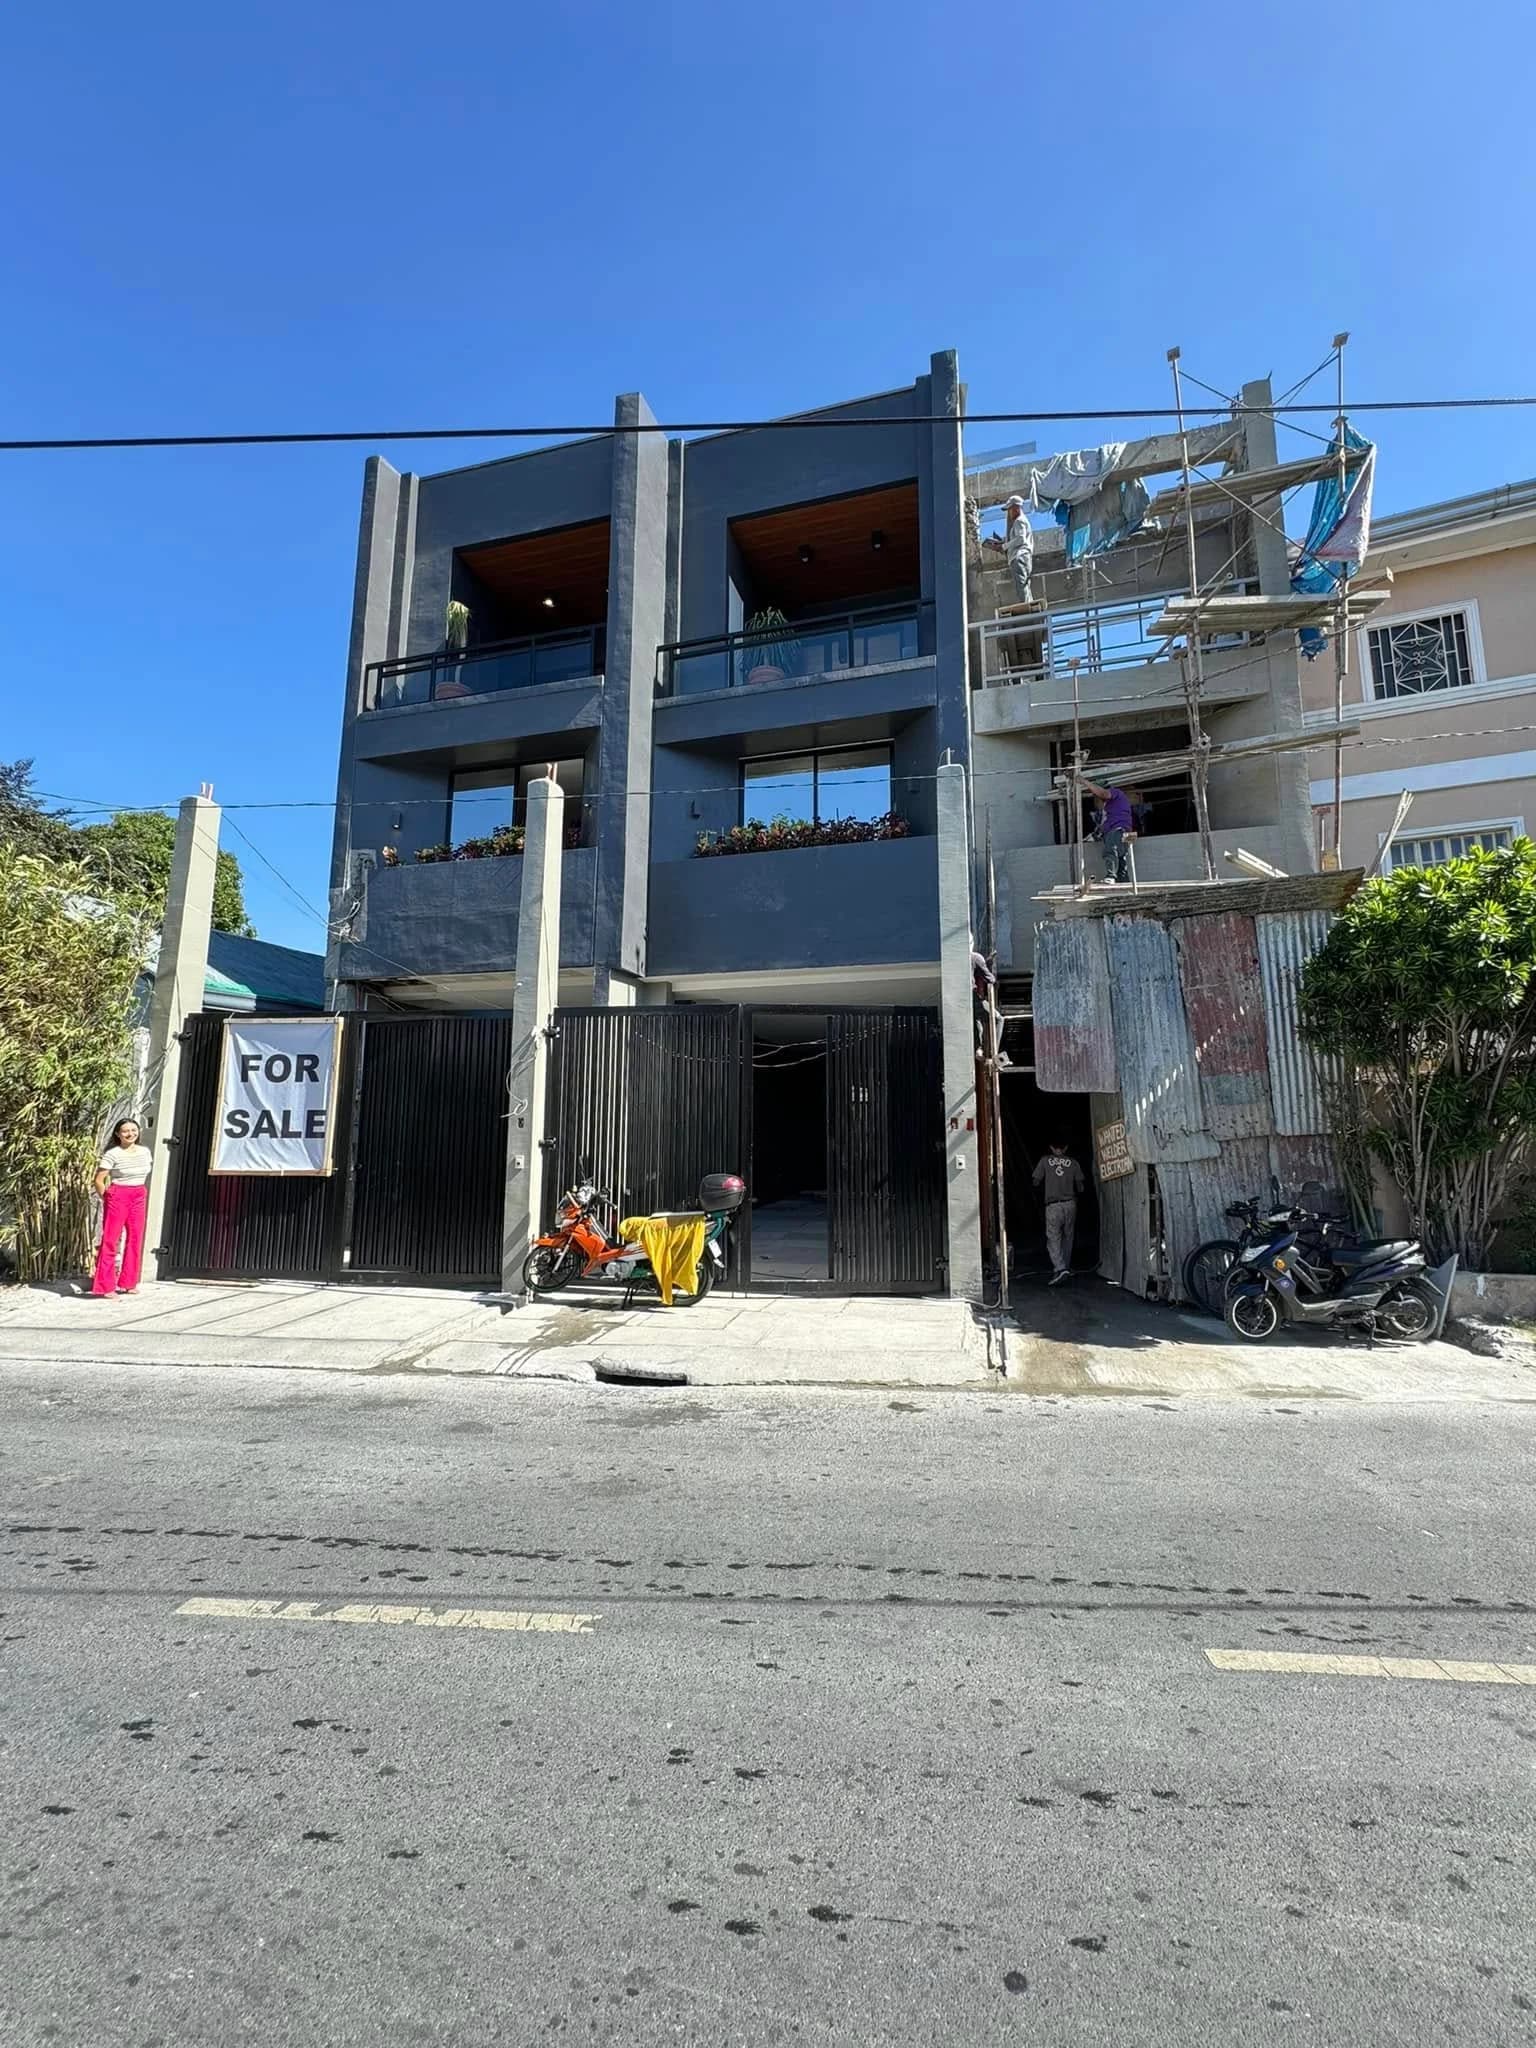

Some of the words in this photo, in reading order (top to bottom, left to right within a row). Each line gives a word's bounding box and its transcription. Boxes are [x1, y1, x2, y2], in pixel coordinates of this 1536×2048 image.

[240, 1054, 320, 1083] FOR
[224, 1109, 328, 1139] SALE
[1098, 1123, 1126, 1147] WANTED
[1101, 1140, 1127, 1161] WELDER
